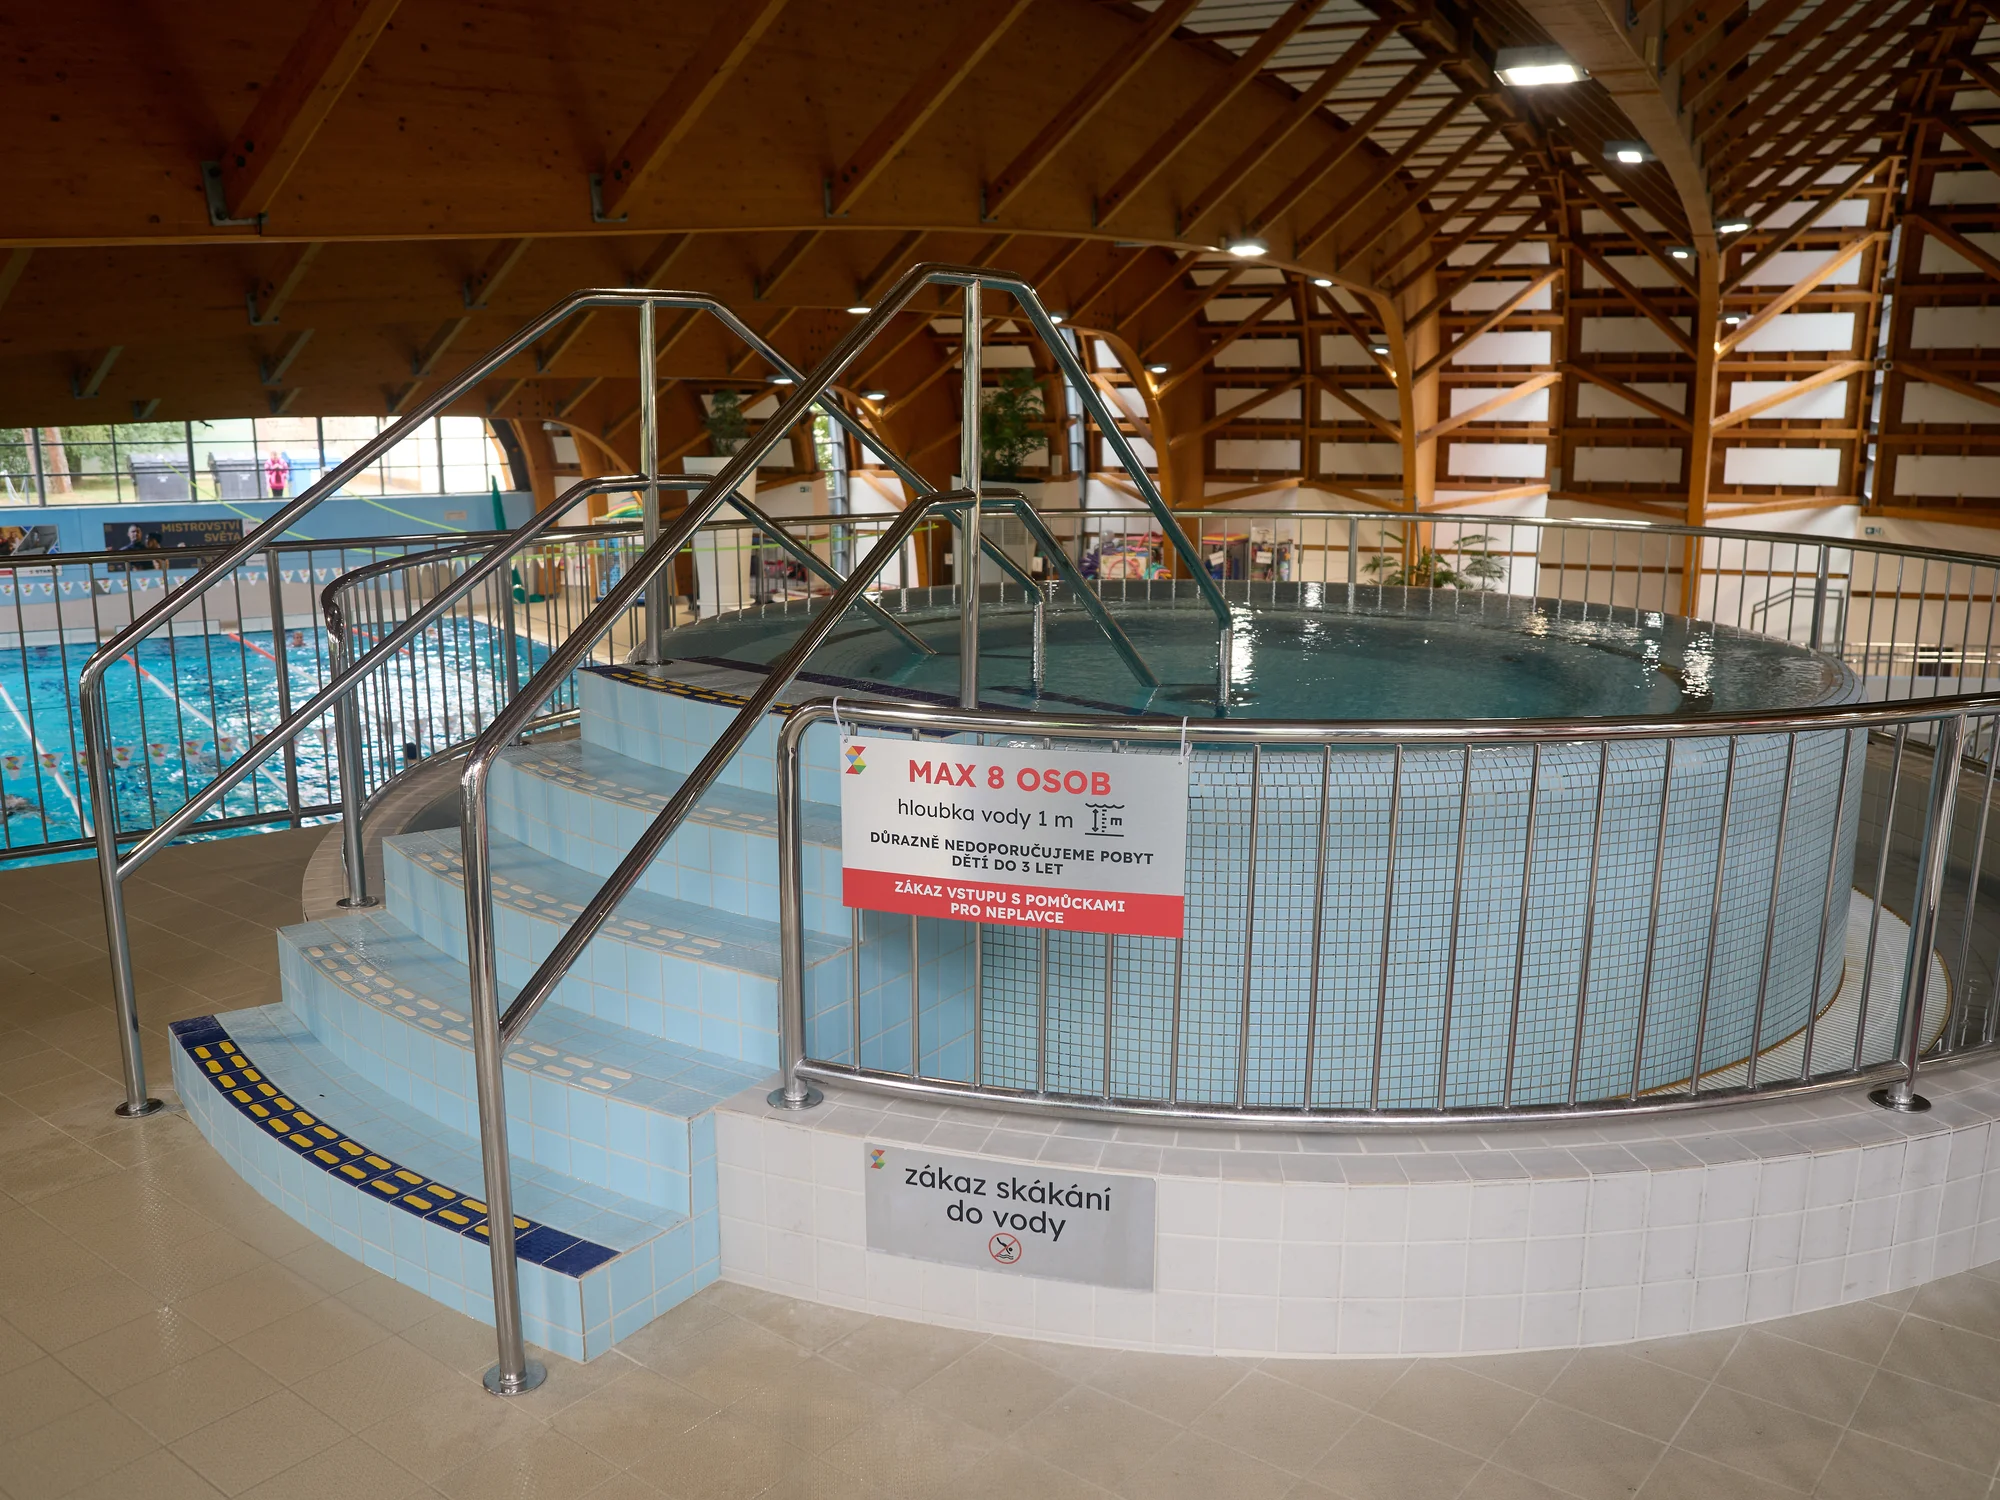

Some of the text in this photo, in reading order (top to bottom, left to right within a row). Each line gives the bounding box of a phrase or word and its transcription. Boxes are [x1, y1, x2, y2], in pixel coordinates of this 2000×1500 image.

[161, 519, 240, 533] MISTROVSTVÍ
[204, 532, 241, 543] SVĚTA
[909, 759, 1111, 796] MAX 8 OSOB
[898, 798, 1074, 830] hloubka vody 1 m
[870, 830, 1155, 866] DŮRAZNĚ NEDOPORUČUJEME POBYT
[951, 853, 1065, 876] DĚTÍ DO 3 LET
[894, 880, 1126, 914] ZÁKAZ VSTUPU S POMŮCKAMI
[950, 902, 1065, 925] PRO NEPLAVCE
[904, 1163, 1112, 1212] zákaz skákání
[946, 1199, 1067, 1243] do vody
